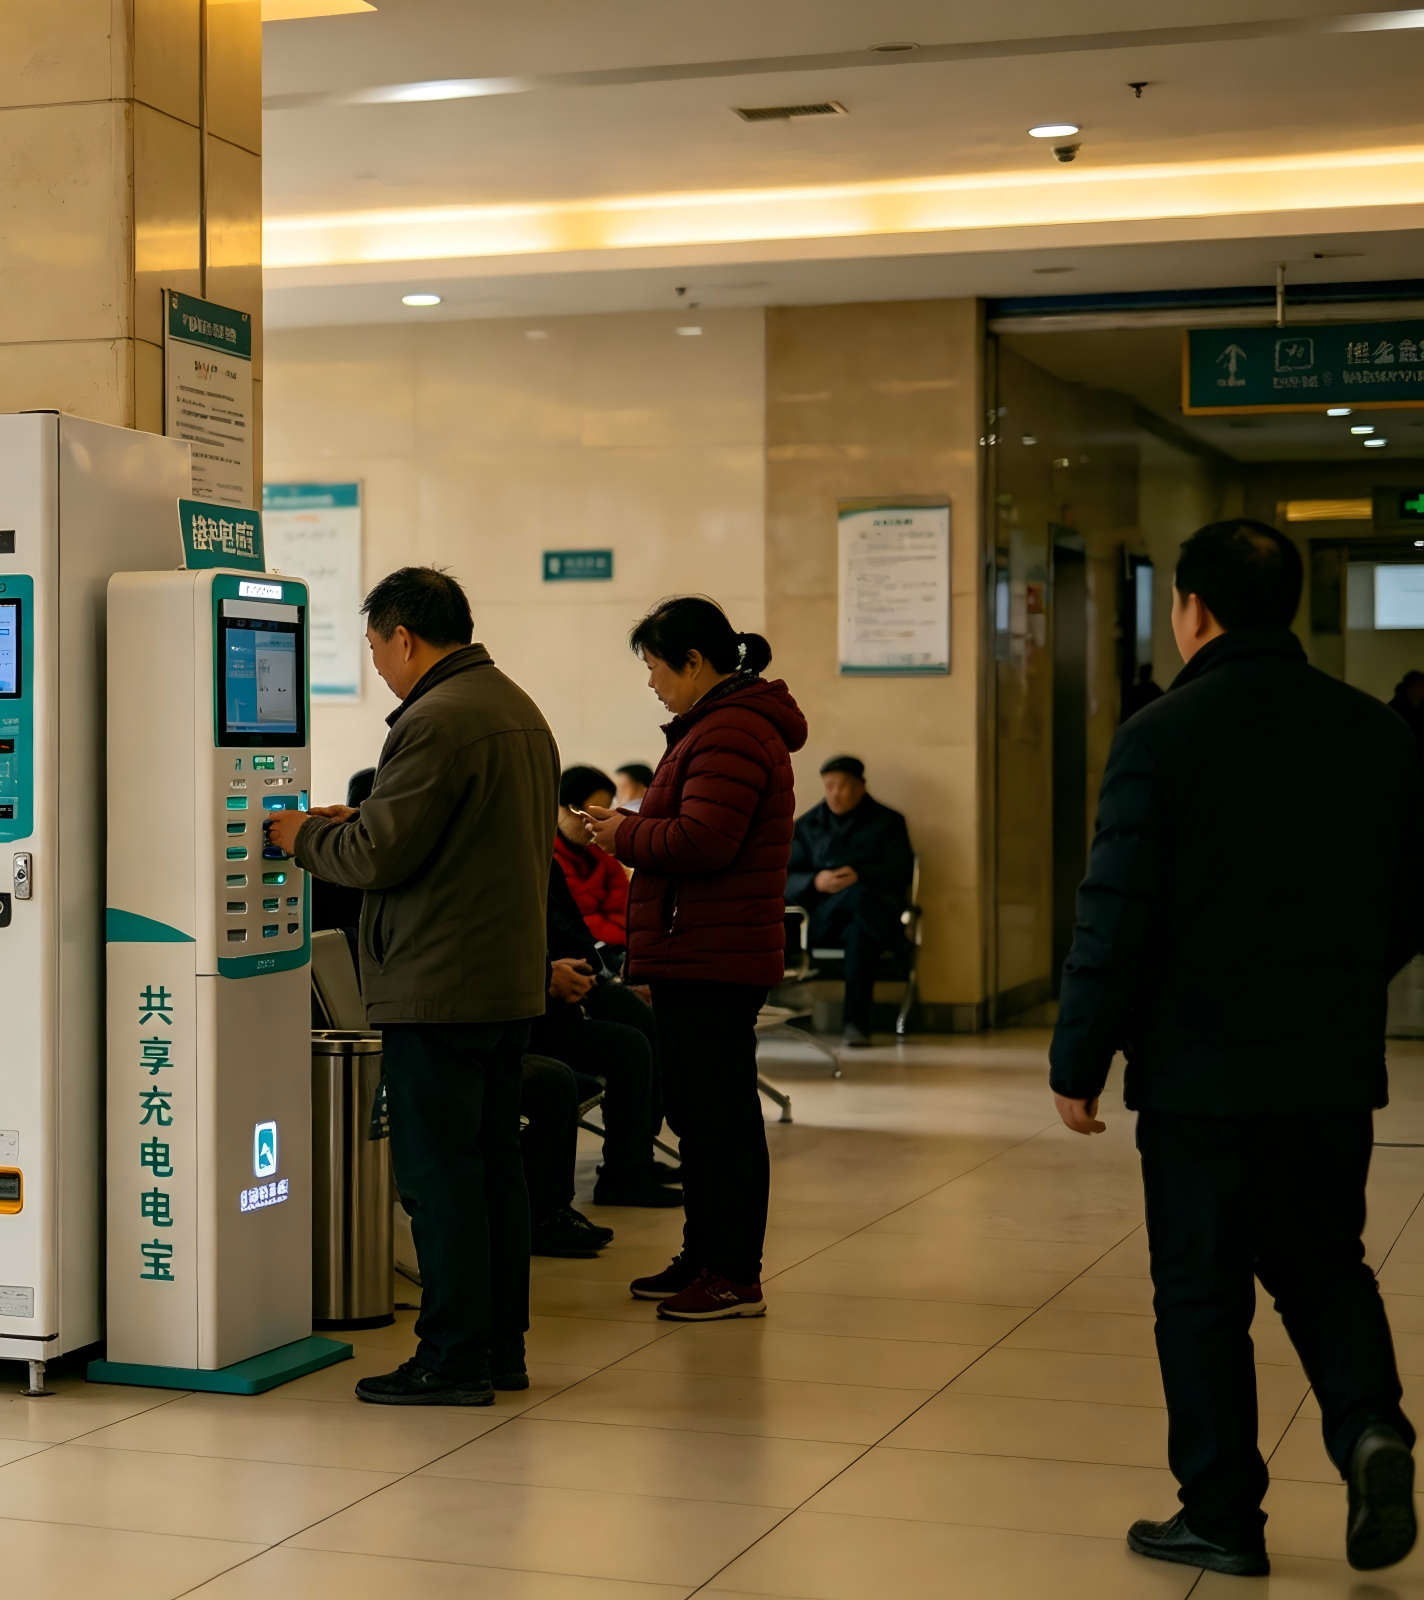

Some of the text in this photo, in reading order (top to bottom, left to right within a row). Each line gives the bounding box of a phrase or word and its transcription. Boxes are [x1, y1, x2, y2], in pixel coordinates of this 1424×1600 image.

[139, 985, 174, 1281] 共享充电电宝
